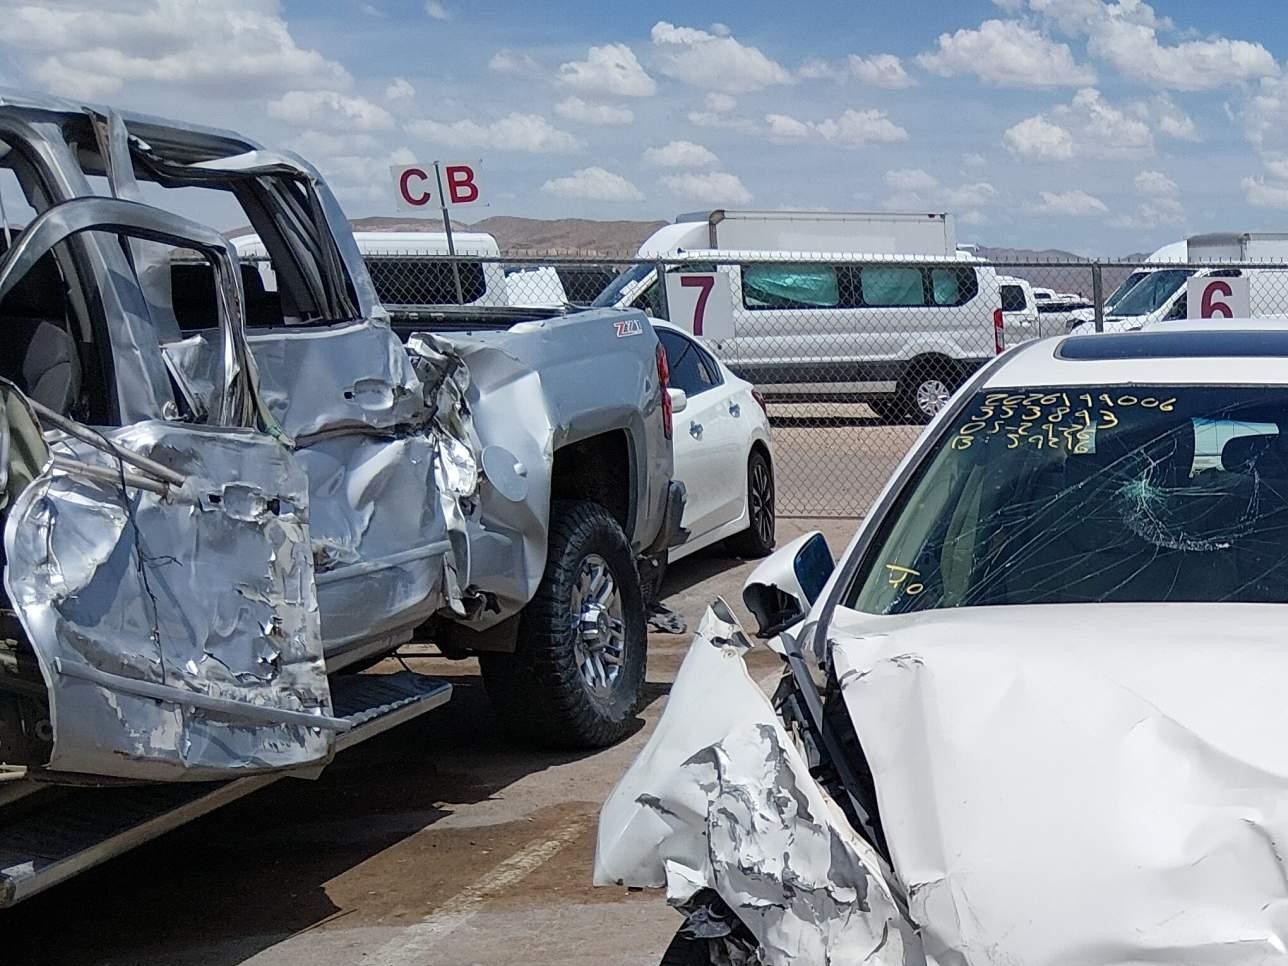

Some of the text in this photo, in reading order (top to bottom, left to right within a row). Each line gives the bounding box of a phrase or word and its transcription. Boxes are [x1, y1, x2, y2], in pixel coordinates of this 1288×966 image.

[400, 168, 431, 206] C
[446, 165, 479, 203] B
[680, 276, 715, 336] 7
[1201, 281, 1234, 319] 6
